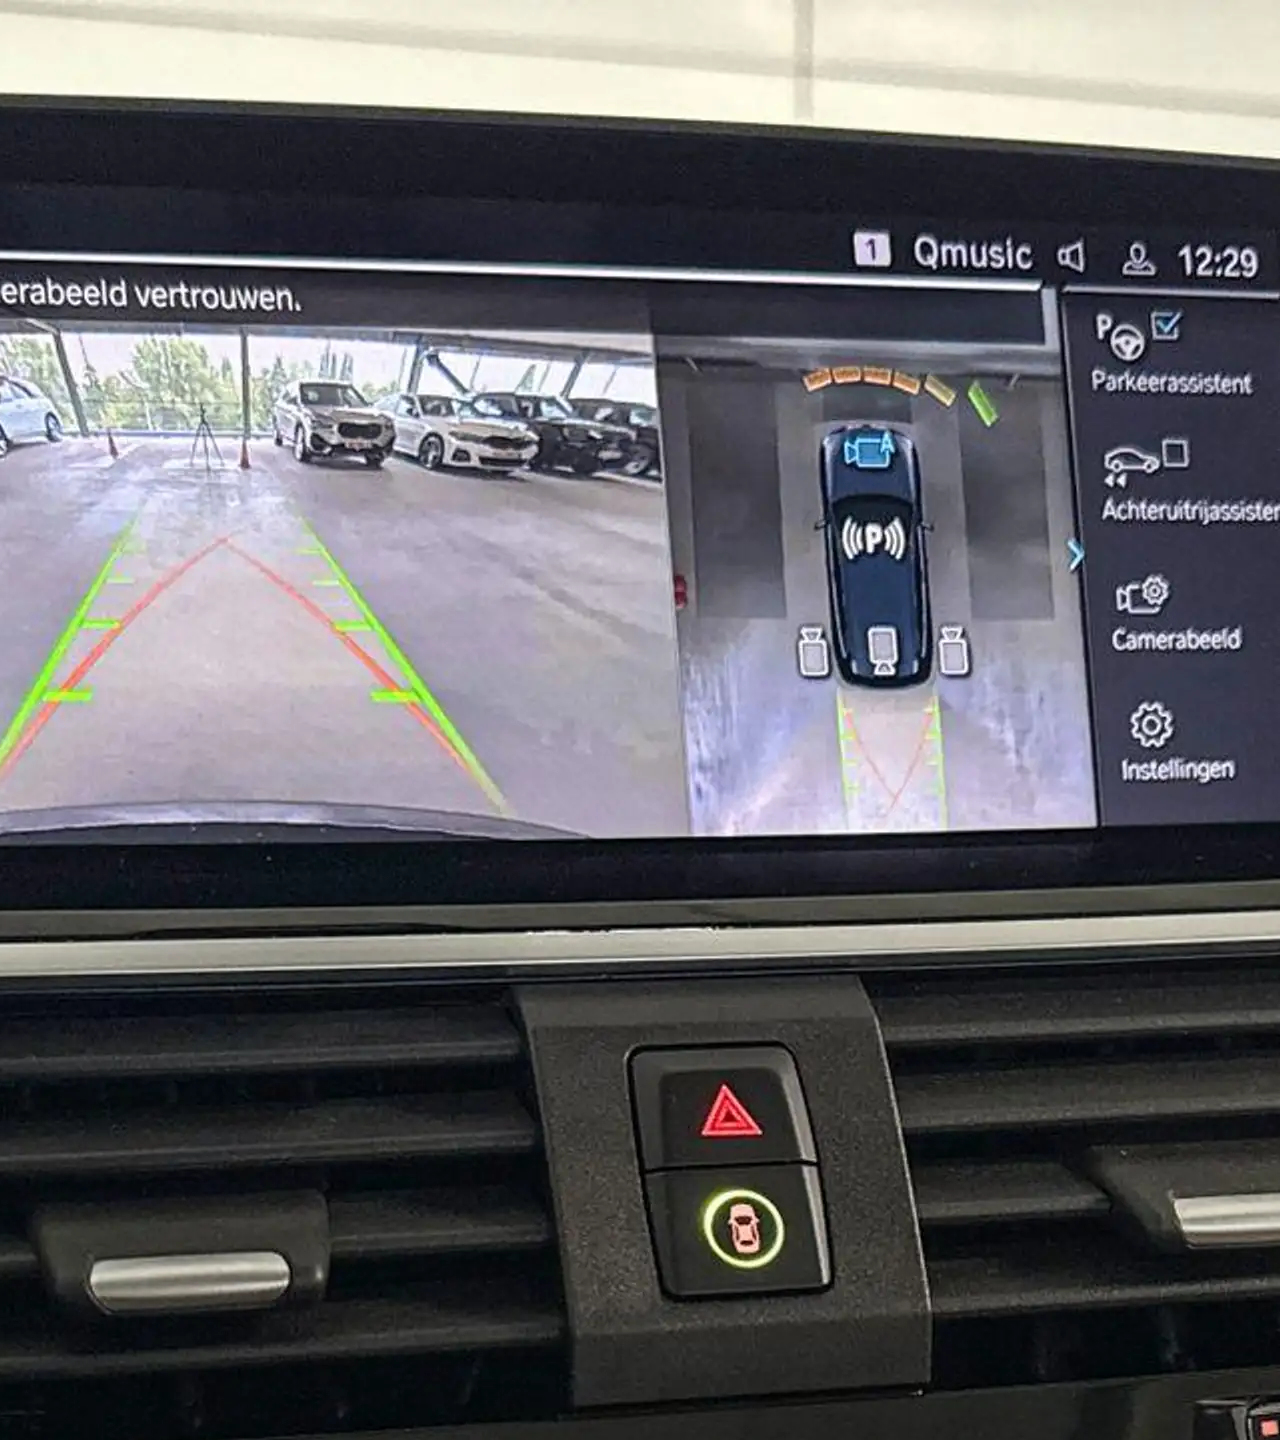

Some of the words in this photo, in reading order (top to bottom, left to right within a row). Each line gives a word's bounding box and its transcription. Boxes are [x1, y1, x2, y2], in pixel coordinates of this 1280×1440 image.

[913, 234, 1033, 272] Qmusic
[1177, 244, 1260, 279] 12:29
[134, 283, 303, 313] vertrouwen.
[1090, 370, 1253, 396] Parkeerassistent
[1111, 626, 1243, 652] Camerabeeld
[1121, 757, 1236, 784] Instellingen
